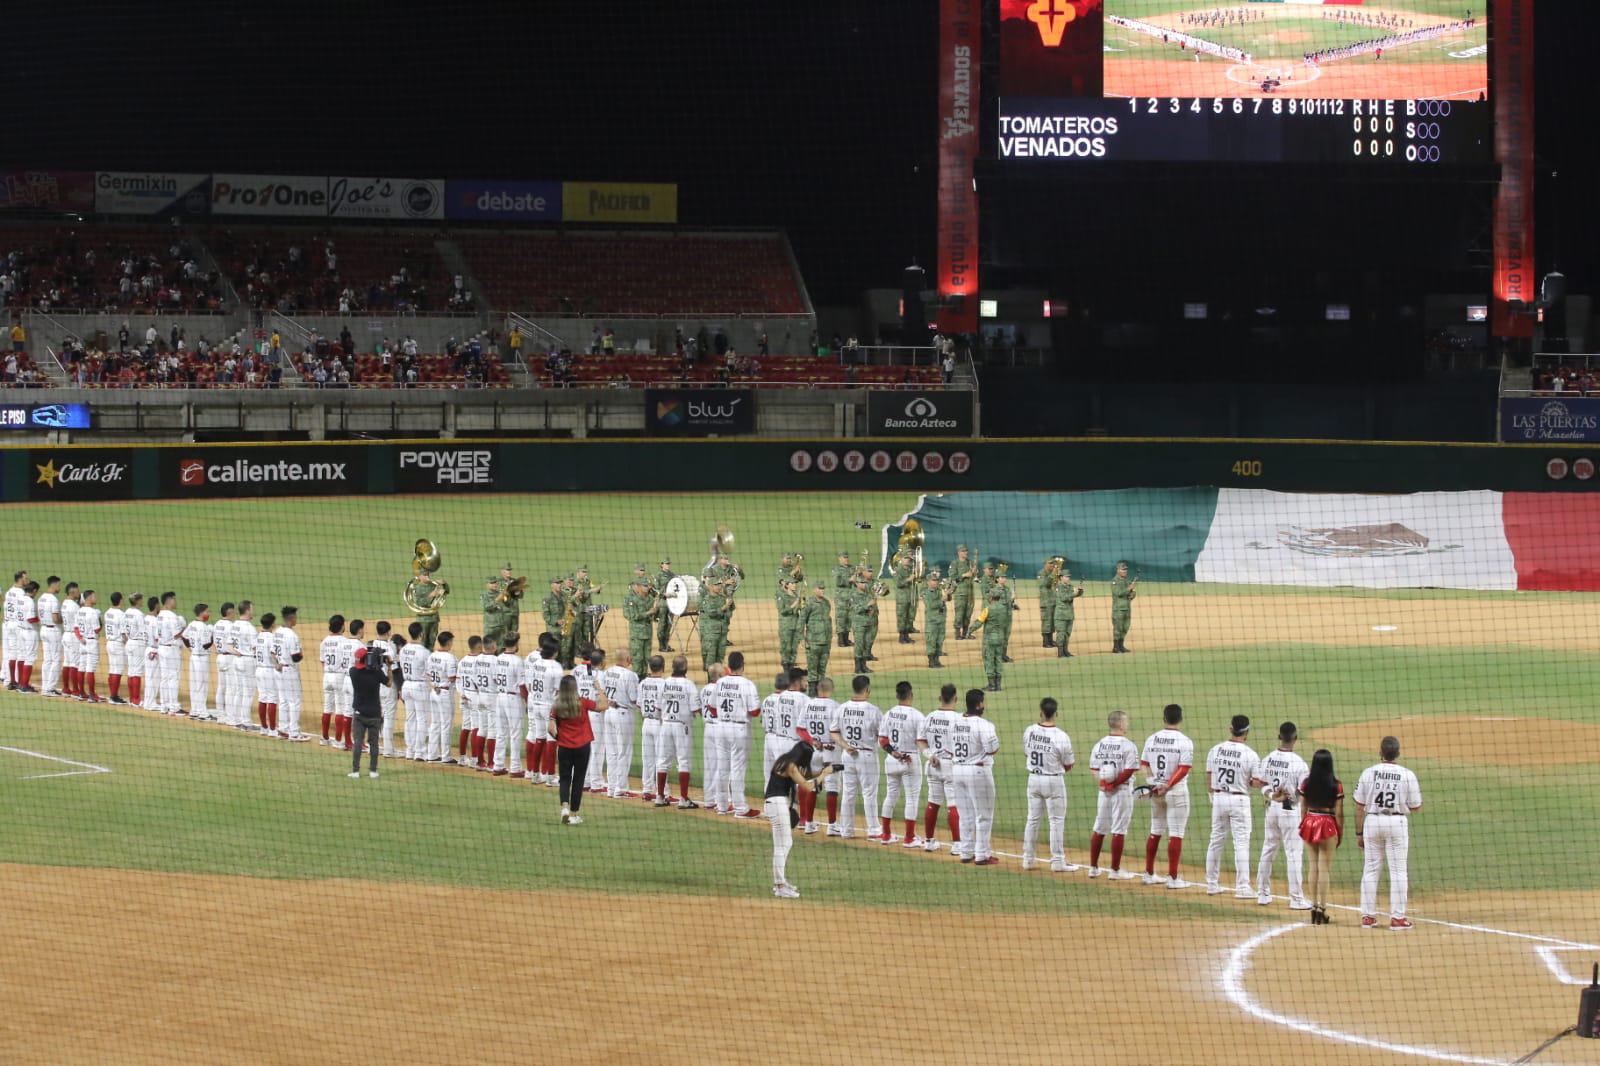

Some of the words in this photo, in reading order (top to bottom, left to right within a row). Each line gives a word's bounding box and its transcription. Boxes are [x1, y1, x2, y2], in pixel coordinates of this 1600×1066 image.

[1130, 98, 1137, 112] 1
[1148, 98, 1158, 112] 2
[1170, 98, 1180, 112] 3
[1190, 98, 1201, 112] 4
[1213, 98, 1224, 112] 5
[1232, 98, 1242, 112] 6
[1252, 98, 1262, 114] 7
[1272, 98, 1282, 114] 8
[1288, 98, 1297, 114] 9
[1300, 99, 1314, 114] 10
[1315, 99, 1328, 114] 11
[1330, 99, 1344, 114] 12
[1353, 100, 1362, 114] R
[1369, 100, 1378, 114] H
[1386, 100, 1394, 114] E
[1406, 100, 1416, 116] B
[1000, 116, 1118, 134] TOMATEROS
[1354, 117, 1361, 133] 0
[1370, 117, 1378, 133] 0
[1386, 117, 1393, 133] 0
[1406, 122, 1416, 138] S
[1000, 137, 1106, 157] VENADOS
[1354, 140, 1361, 156] 0
[1370, 140, 1378, 156] 0
[1386, 140, 1393, 156] 0
[1406, 144, 1417, 161] O
[98, 173, 176, 190] Germixin
[330, 178, 393, 215] Joe's
[477, 191, 546, 212] debate
[8, 410, 26, 424] PISO
[884, 418, 918, 428] Banco
[920, 418, 956, 428] Azteca
[1512, 416, 1536, 428] LAS
[1540, 416, 1597, 428] PUERTAS
[400, 450, 492, 468] POWER
[59, 463, 100, 483] Carl's
[102, 463, 122, 482] Jr.
[208, 460, 346, 482] caliente.mx
[438, 466, 490, 484] ADE
[1232, 460, 1262, 476] 400
[326, 654, 336, 666] 30
[477, 674, 489, 688] 33
[666, 700, 680, 714] 70
[720, 698, 734, 712] 45
[780, 714, 791, 728] 16
[810, 720, 825, 736] 99
[846, 726, 862, 740] 39
[892, 728, 899, 743] 8
[934, 735, 942, 750] 5
[955, 742, 969, 758] 29
[1028, 742, 1051, 752] ALVAREZ
[1030, 750, 1044, 768] 91
[1156, 754, 1166, 770] 6
[1218, 767, 1236, 785] 79
[1374, 792, 1396, 808] 42
